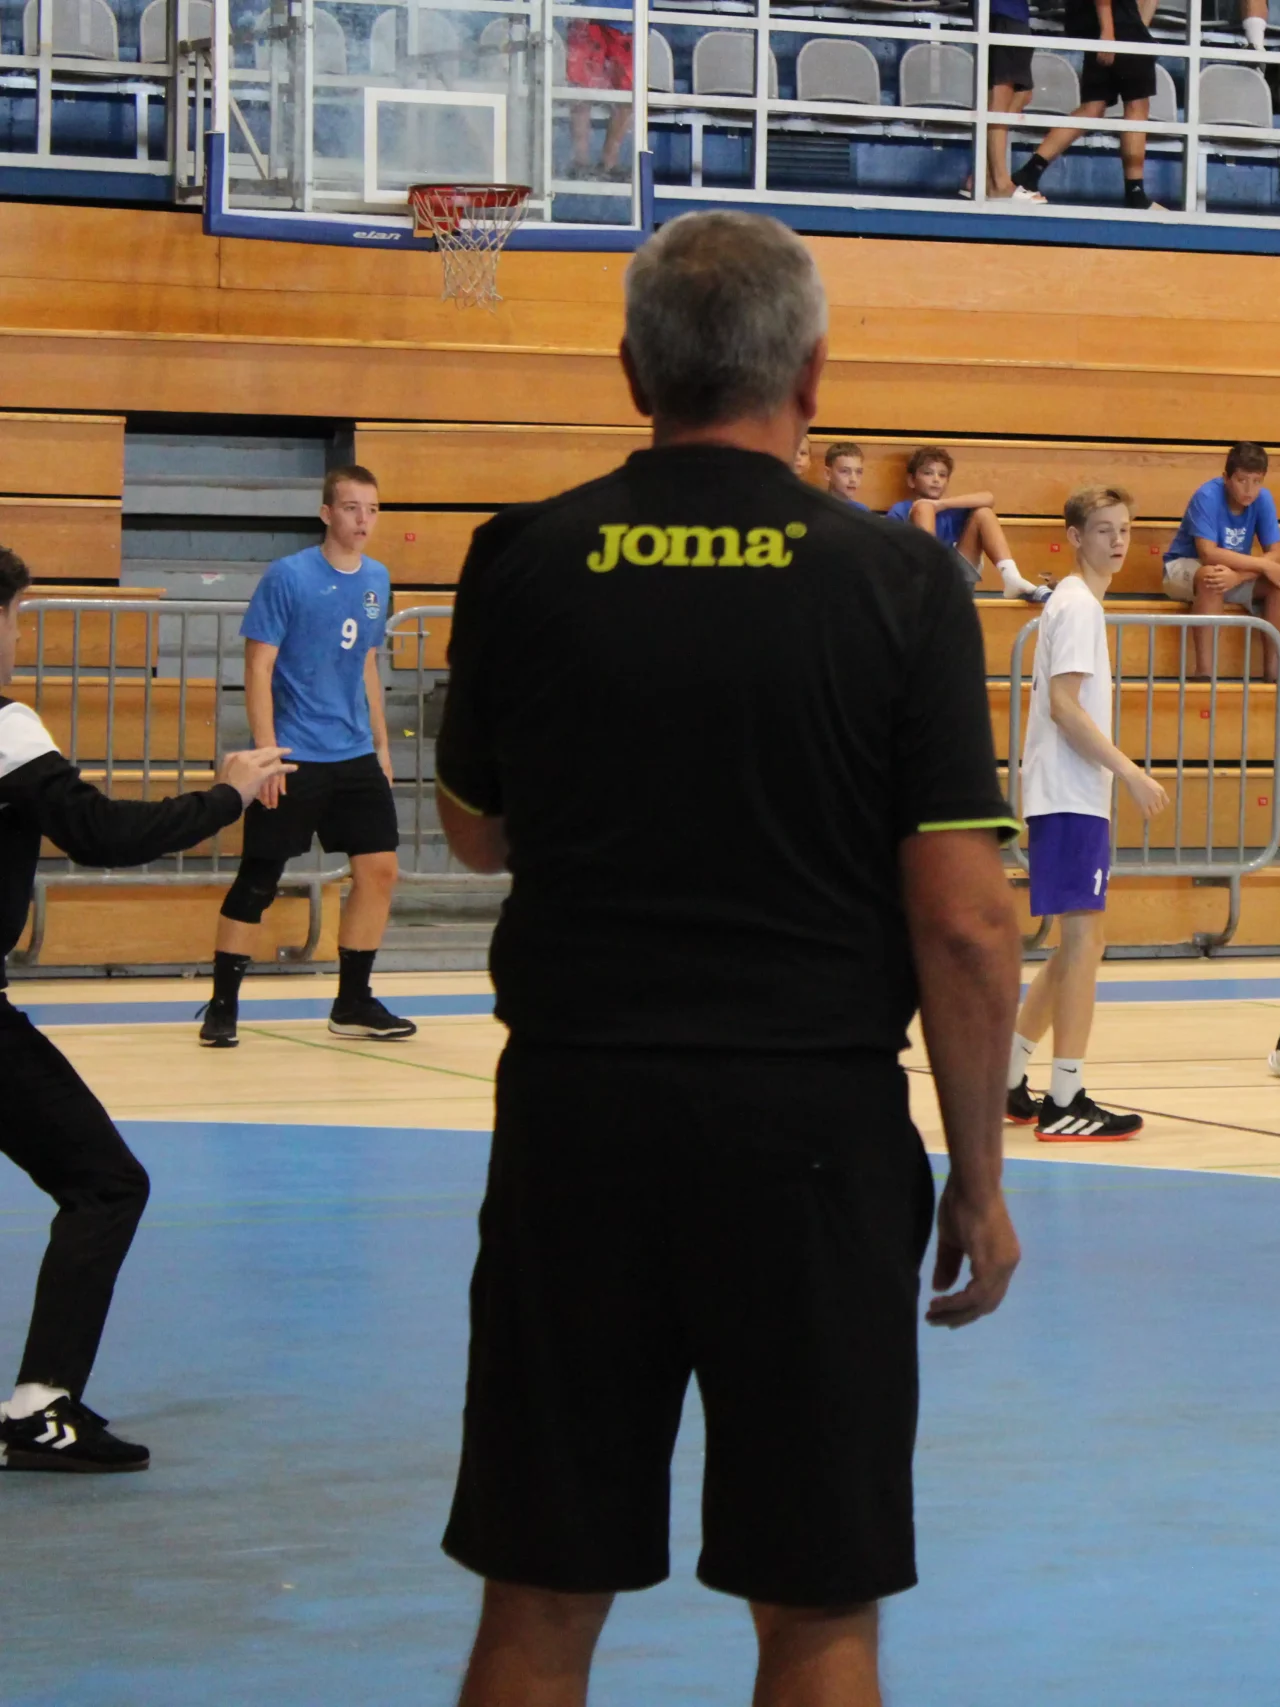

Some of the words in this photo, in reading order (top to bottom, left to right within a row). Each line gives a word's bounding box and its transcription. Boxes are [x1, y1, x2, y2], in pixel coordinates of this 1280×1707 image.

[352, 230, 402, 241] elan
[340, 618, 358, 650] 9
[1093, 867, 1111, 897] 1
